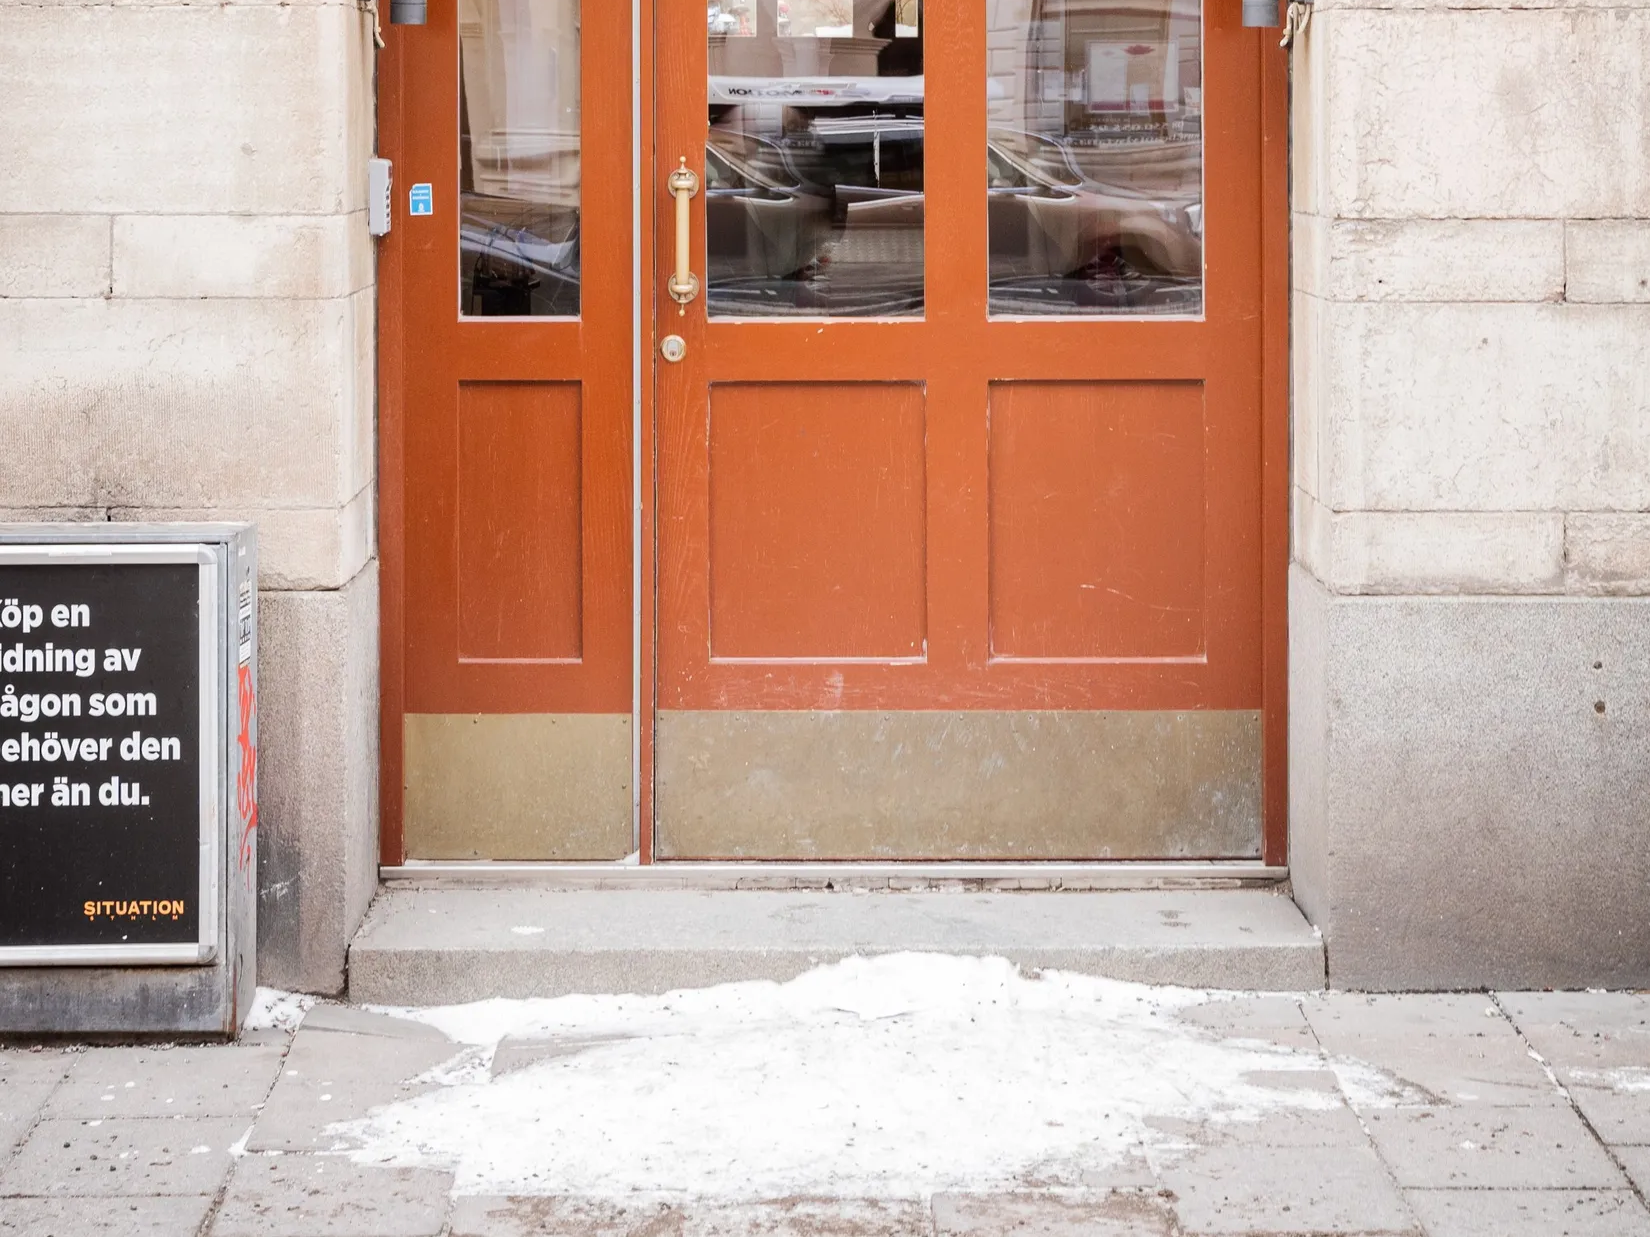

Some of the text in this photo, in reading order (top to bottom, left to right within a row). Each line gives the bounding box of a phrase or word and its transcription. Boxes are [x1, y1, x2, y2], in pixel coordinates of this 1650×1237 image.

[0, 598, 90, 633] öp en
[0, 643, 141, 677] dning av
[88, 693, 157, 716] som
[120, 730, 181, 761] den
[51, 776, 91, 807] än
[98, 776, 150, 807] du.
[83, 900, 184, 916] SITUATION
